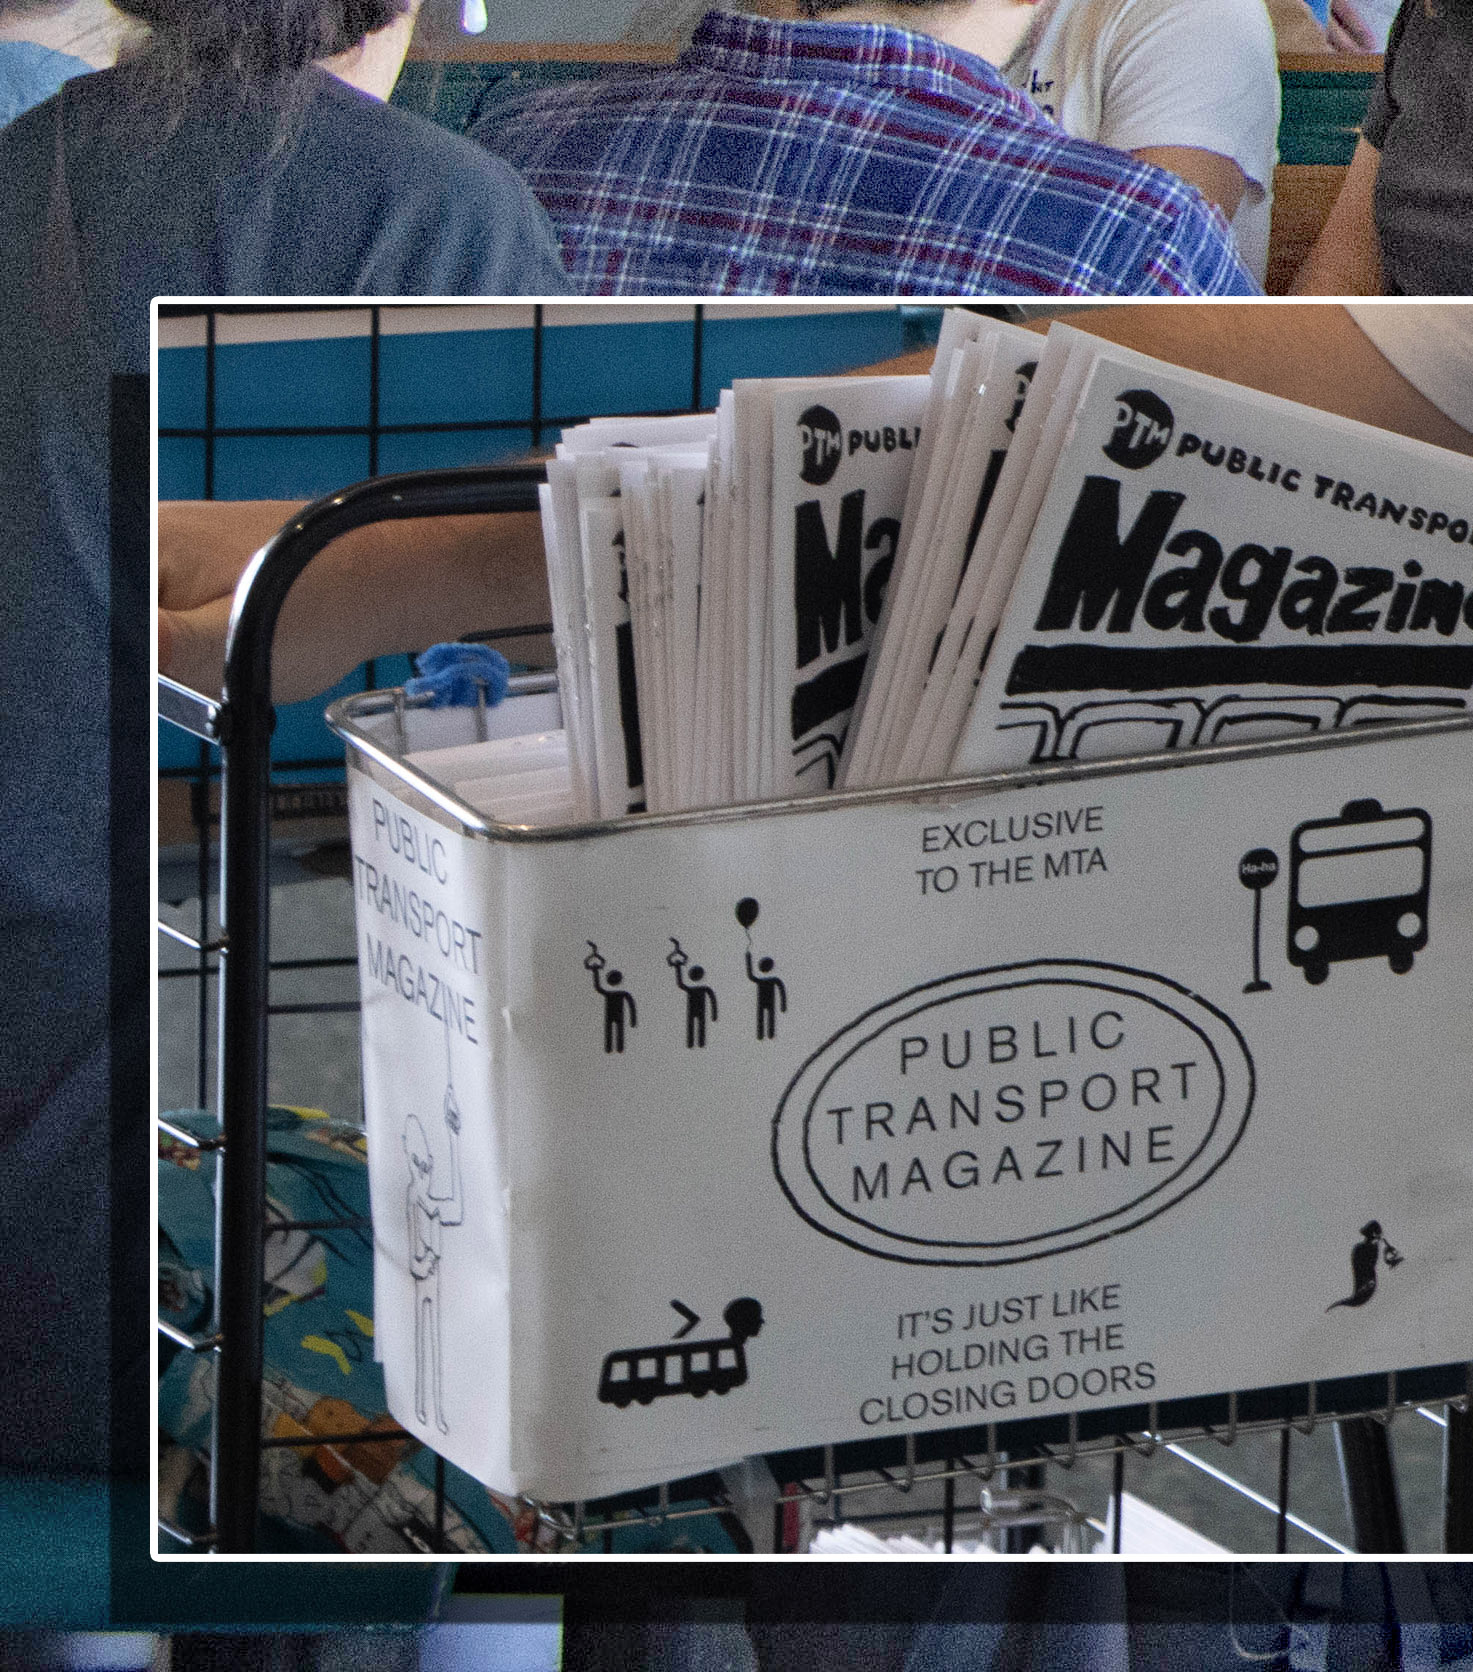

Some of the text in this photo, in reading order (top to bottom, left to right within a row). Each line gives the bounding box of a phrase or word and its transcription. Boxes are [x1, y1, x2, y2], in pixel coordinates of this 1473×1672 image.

[848, 426, 923, 456] PUBLI
[1176, 432, 1302, 493] PUBLIC
[372, 799, 449, 886] PUBLIC
[921, 806, 1105, 855] EXCLUSIVE
[915, 846, 1108, 896] TO THE MTA
[355, 852, 483, 977] TRANSPORT
[365, 930, 480, 1047] MAGAZINE
[899, 1009, 1127, 1077] PUBLIC
[828, 1059, 1200, 1148] TRANSPORT
[853, 1124, 1177, 1203] MAGAZINE
[897, 1284, 1122, 1342] IT'S JUST LIKE
[890, 1323, 1126, 1382] HOLDING THE
[857, 1361, 1158, 1427] CLOSING DOORS
